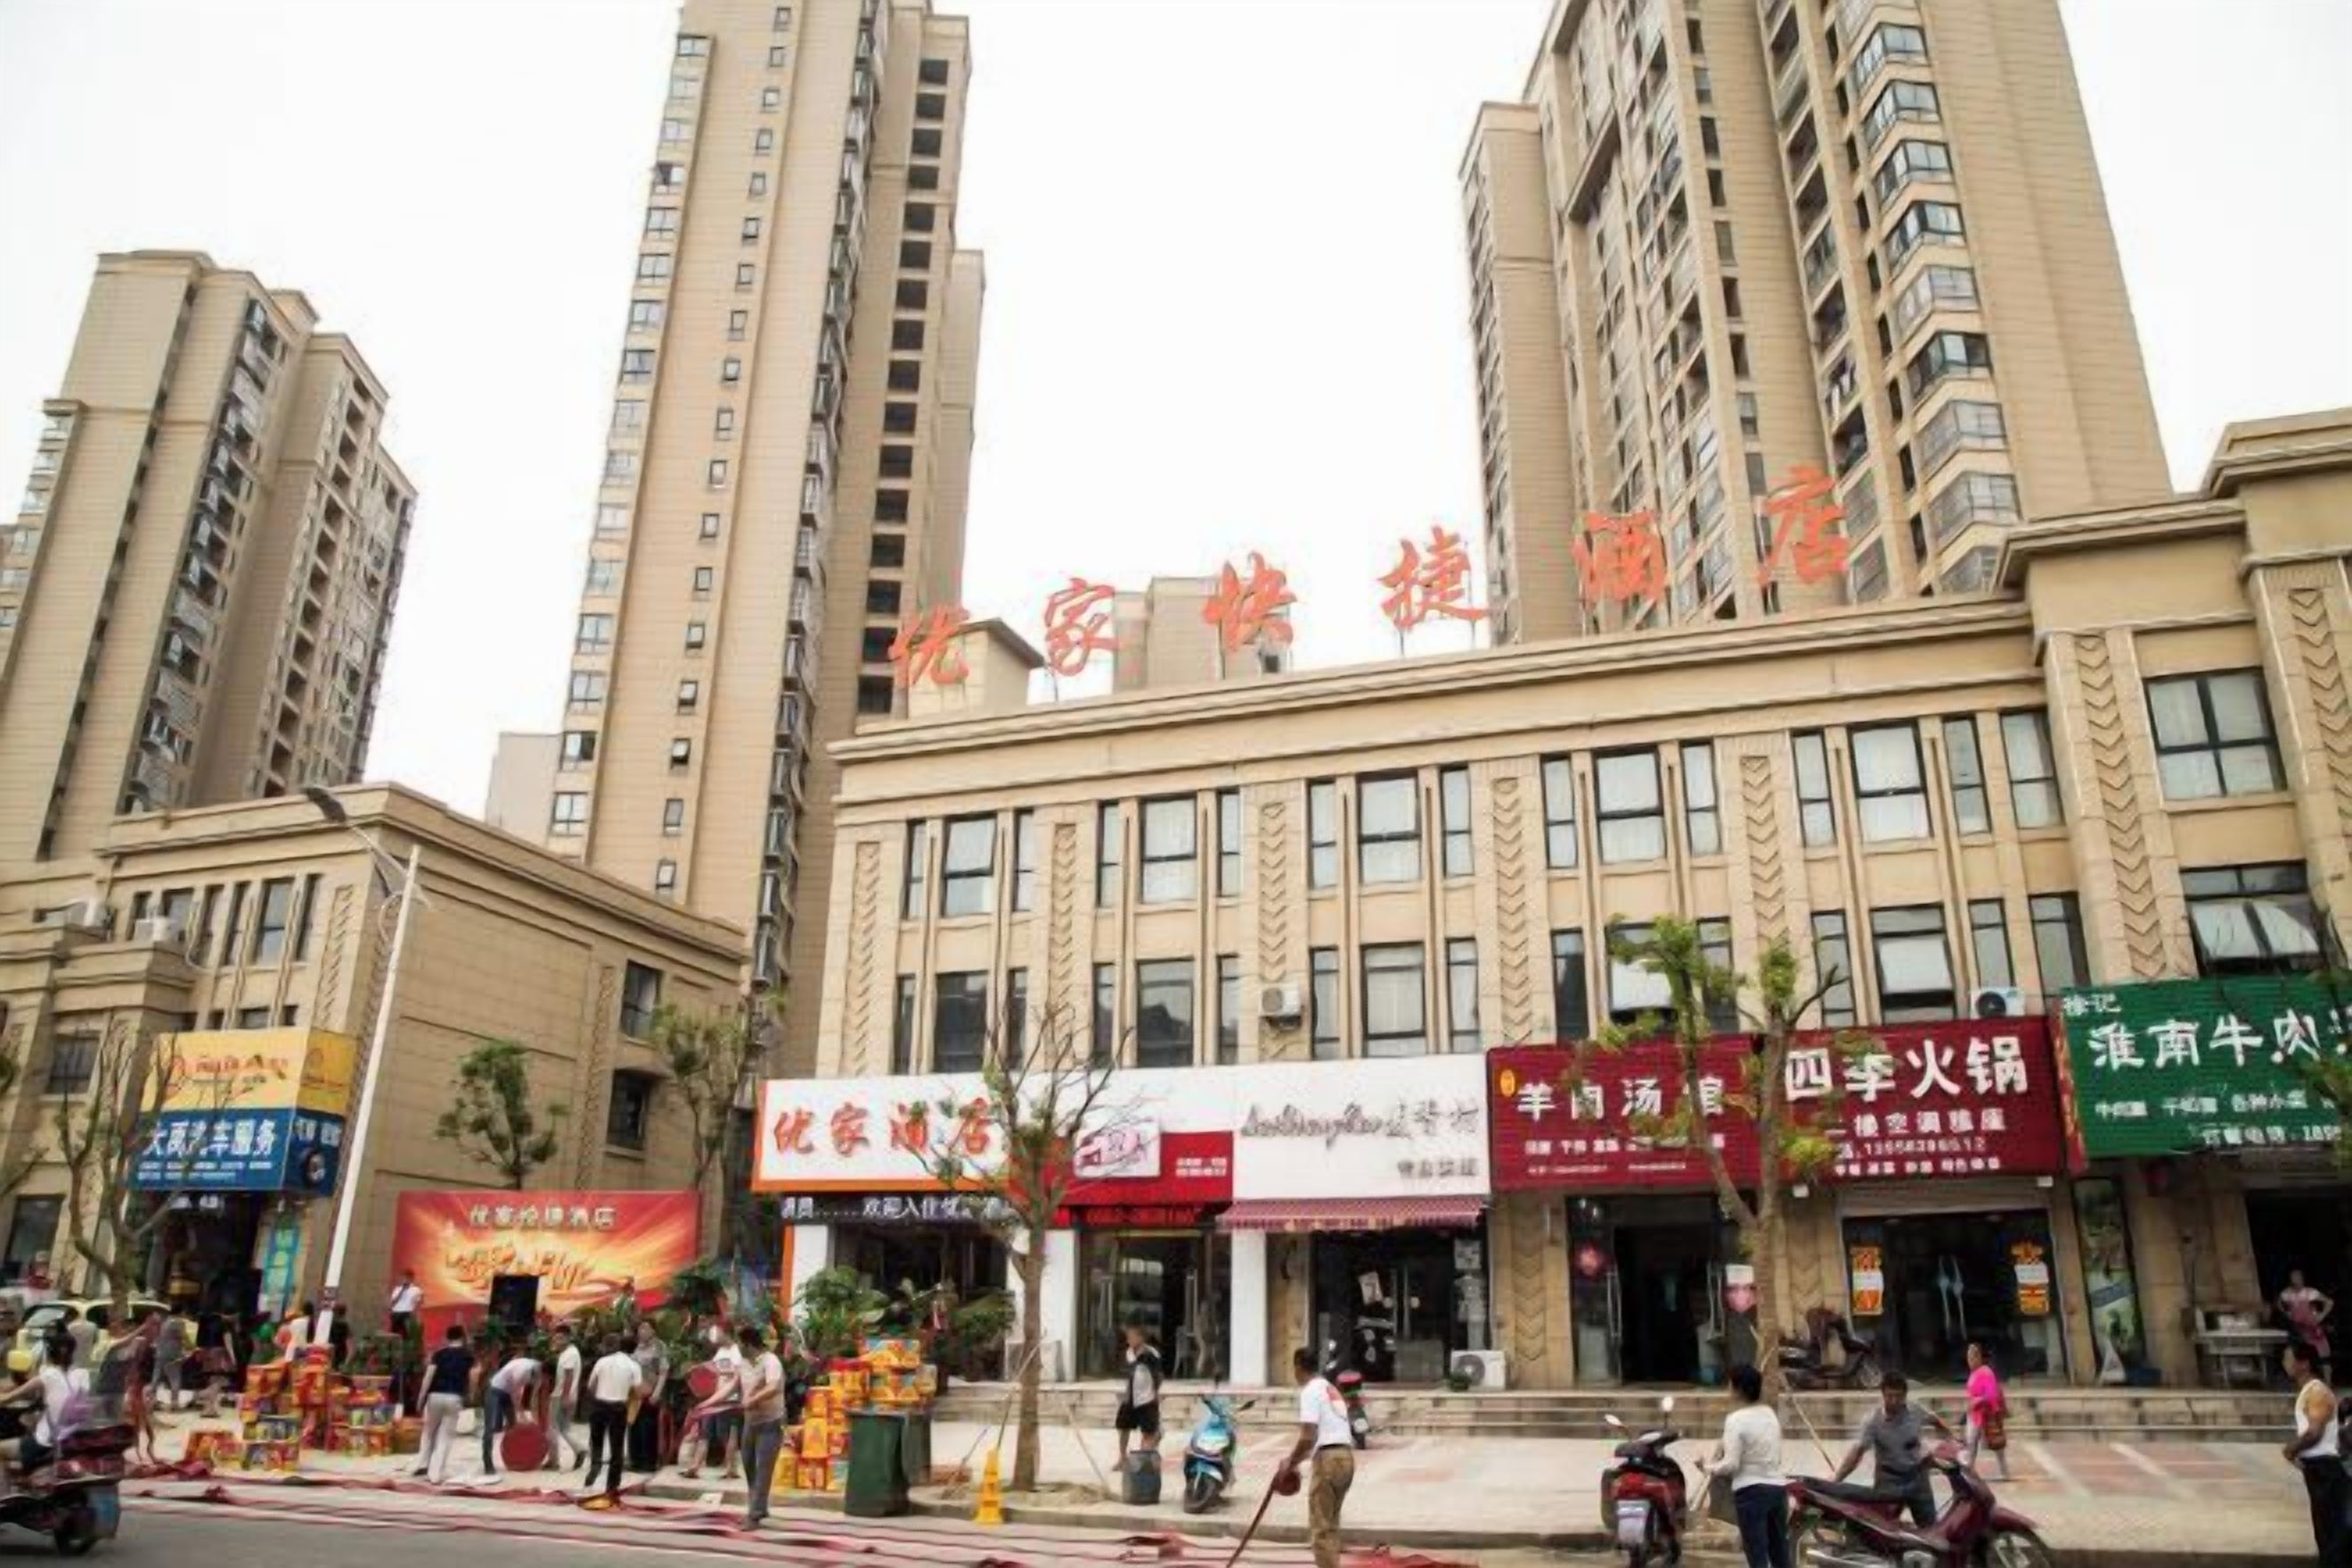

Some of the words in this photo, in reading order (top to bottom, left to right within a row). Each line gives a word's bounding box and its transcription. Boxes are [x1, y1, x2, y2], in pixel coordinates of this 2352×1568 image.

[887, 464, 1850, 689] 优家快捷酒店
[1784, 1036, 2028, 1102] 四季火锅
[774, 1097, 991, 1157] 优家酒店
